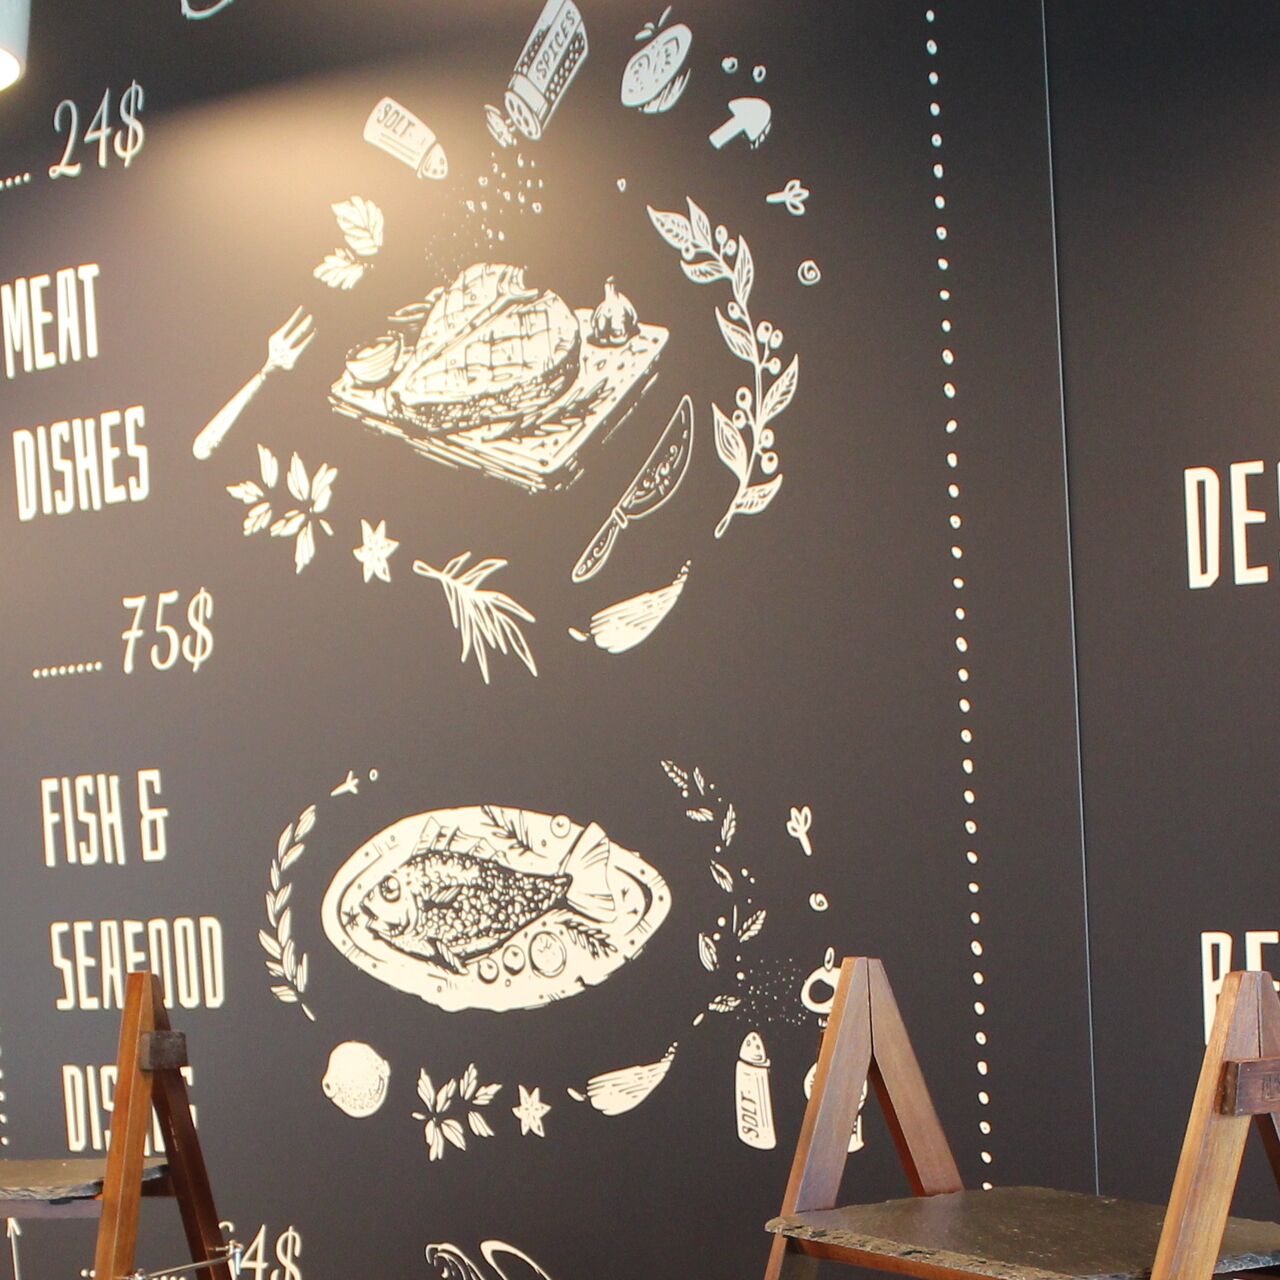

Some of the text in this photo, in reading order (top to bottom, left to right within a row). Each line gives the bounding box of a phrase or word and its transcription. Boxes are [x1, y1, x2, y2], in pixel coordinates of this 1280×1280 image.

[535, 9, 576, 80] SPICES
[48, 80, 144, 178] 24$
[376, 103, 415, 138] SOLT
[1, 264, 99, 378] MEAT
[13, 406, 149, 521] DISHES
[121, 587, 214, 673] 75$
[41, 769, 169, 867] FISH &
[51, 917, 224, 1010] SEAFOOD
[741, 1091, 759, 1138] SOLT
